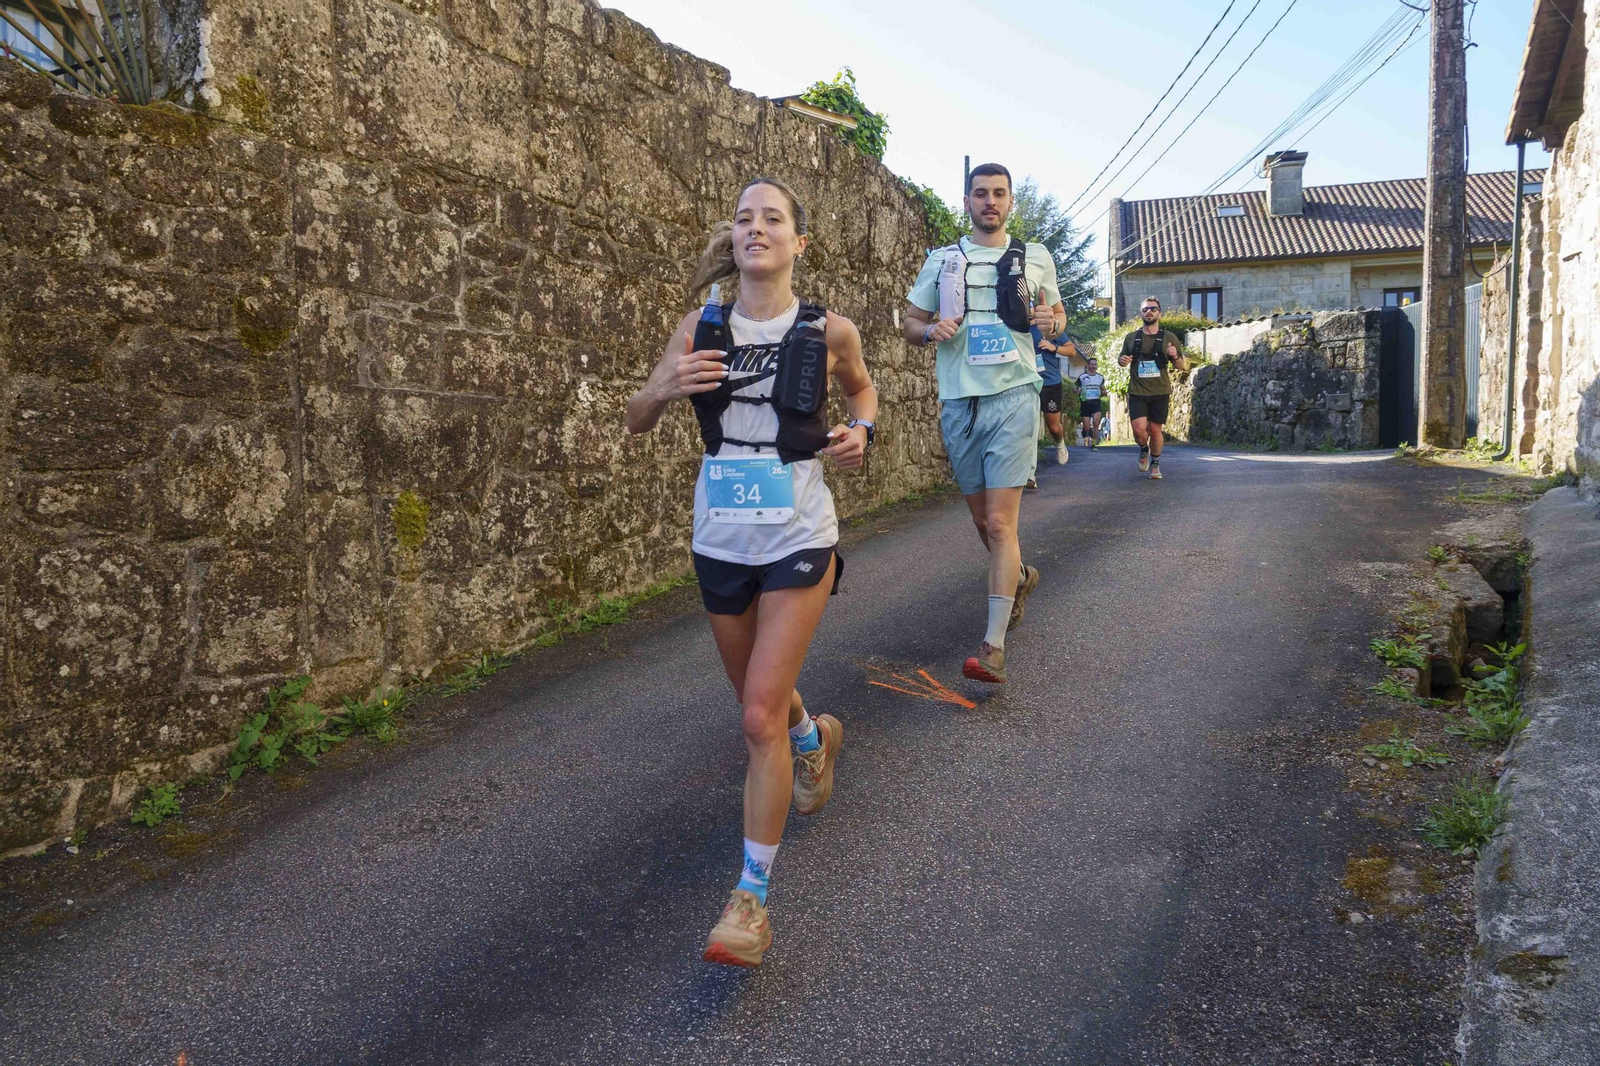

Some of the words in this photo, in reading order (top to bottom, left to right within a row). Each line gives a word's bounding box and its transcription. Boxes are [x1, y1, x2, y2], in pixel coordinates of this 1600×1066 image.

[981, 337, 1007, 352] 227
[731, 349, 779, 373] NIKE
[796, 336, 820, 412] KIPRUN
[732, 483, 762, 505] 34
